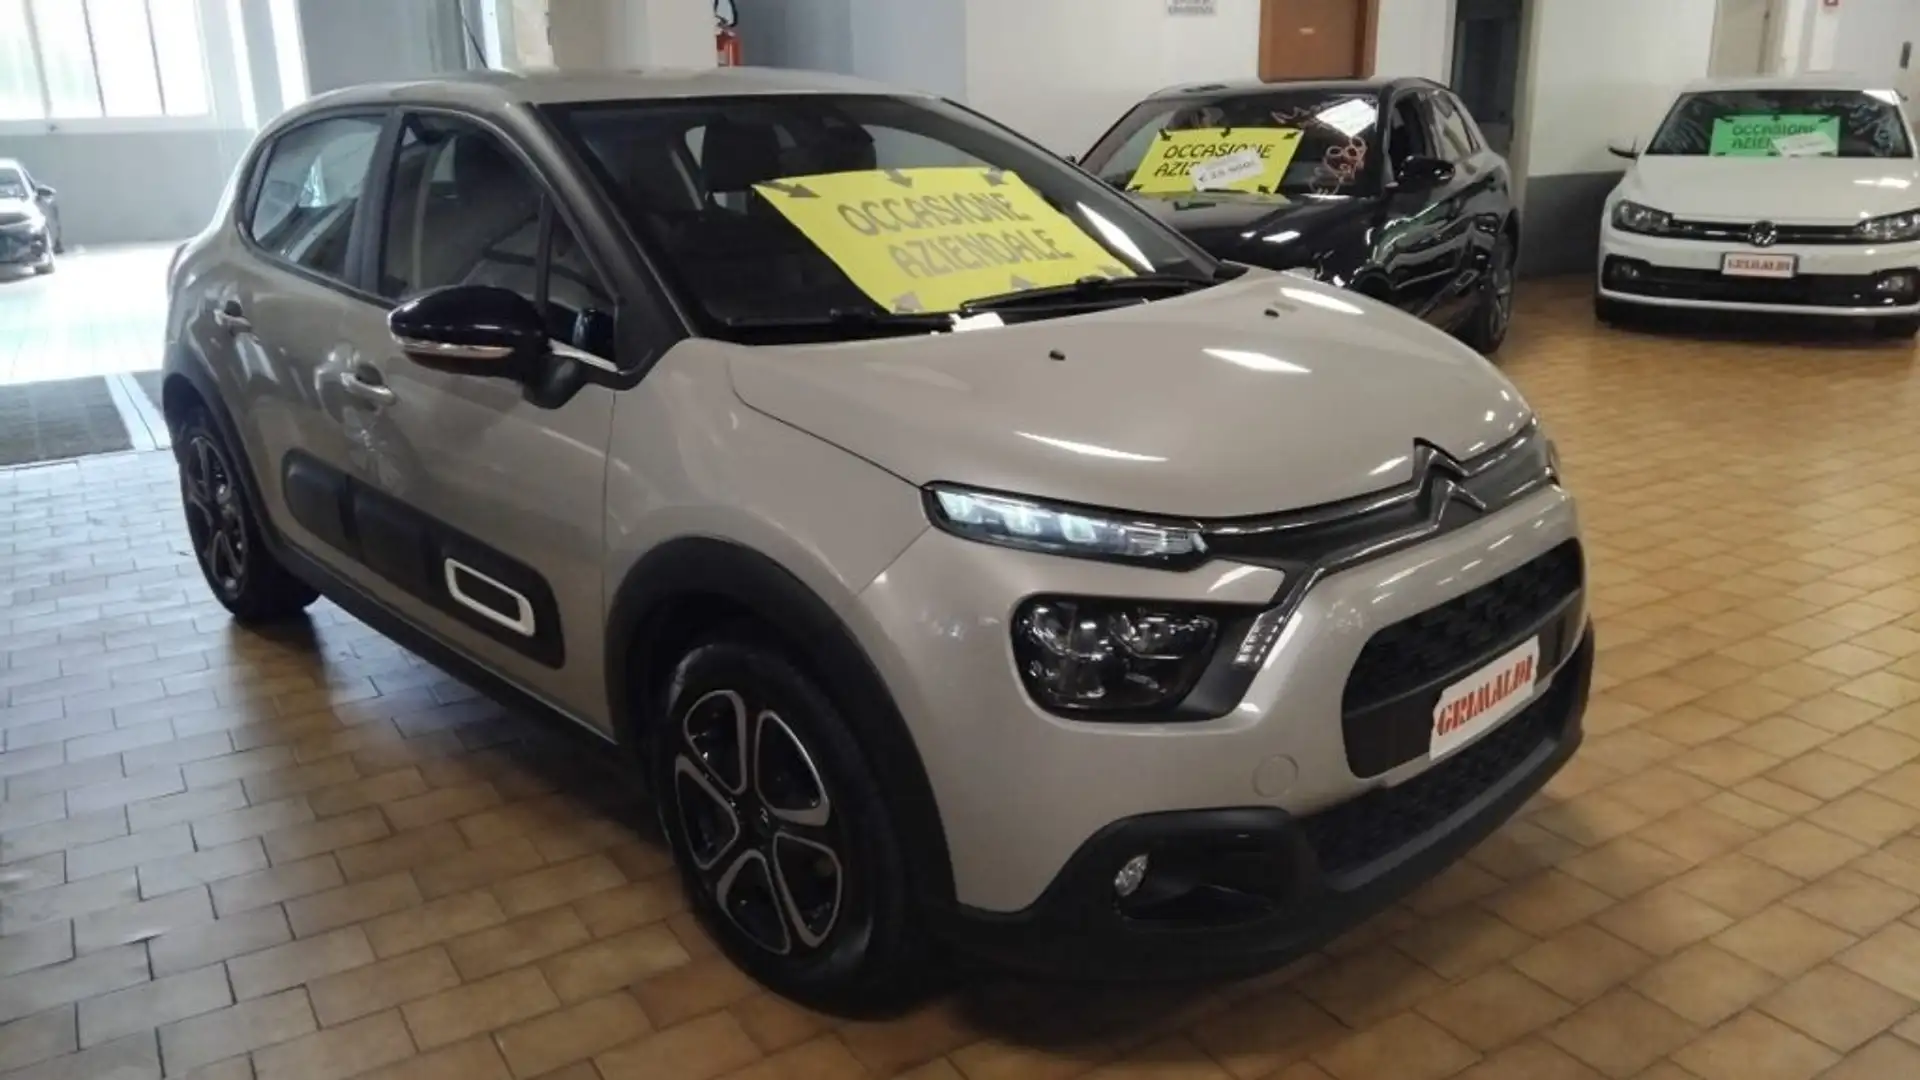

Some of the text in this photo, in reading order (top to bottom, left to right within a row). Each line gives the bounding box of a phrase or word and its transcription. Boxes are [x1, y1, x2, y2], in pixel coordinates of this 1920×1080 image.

[837, 192, 1034, 236] OCCASIONE
[888, 229, 1076, 279] AZIENDALE
[1436, 654, 1533, 736] GRIMALDI
